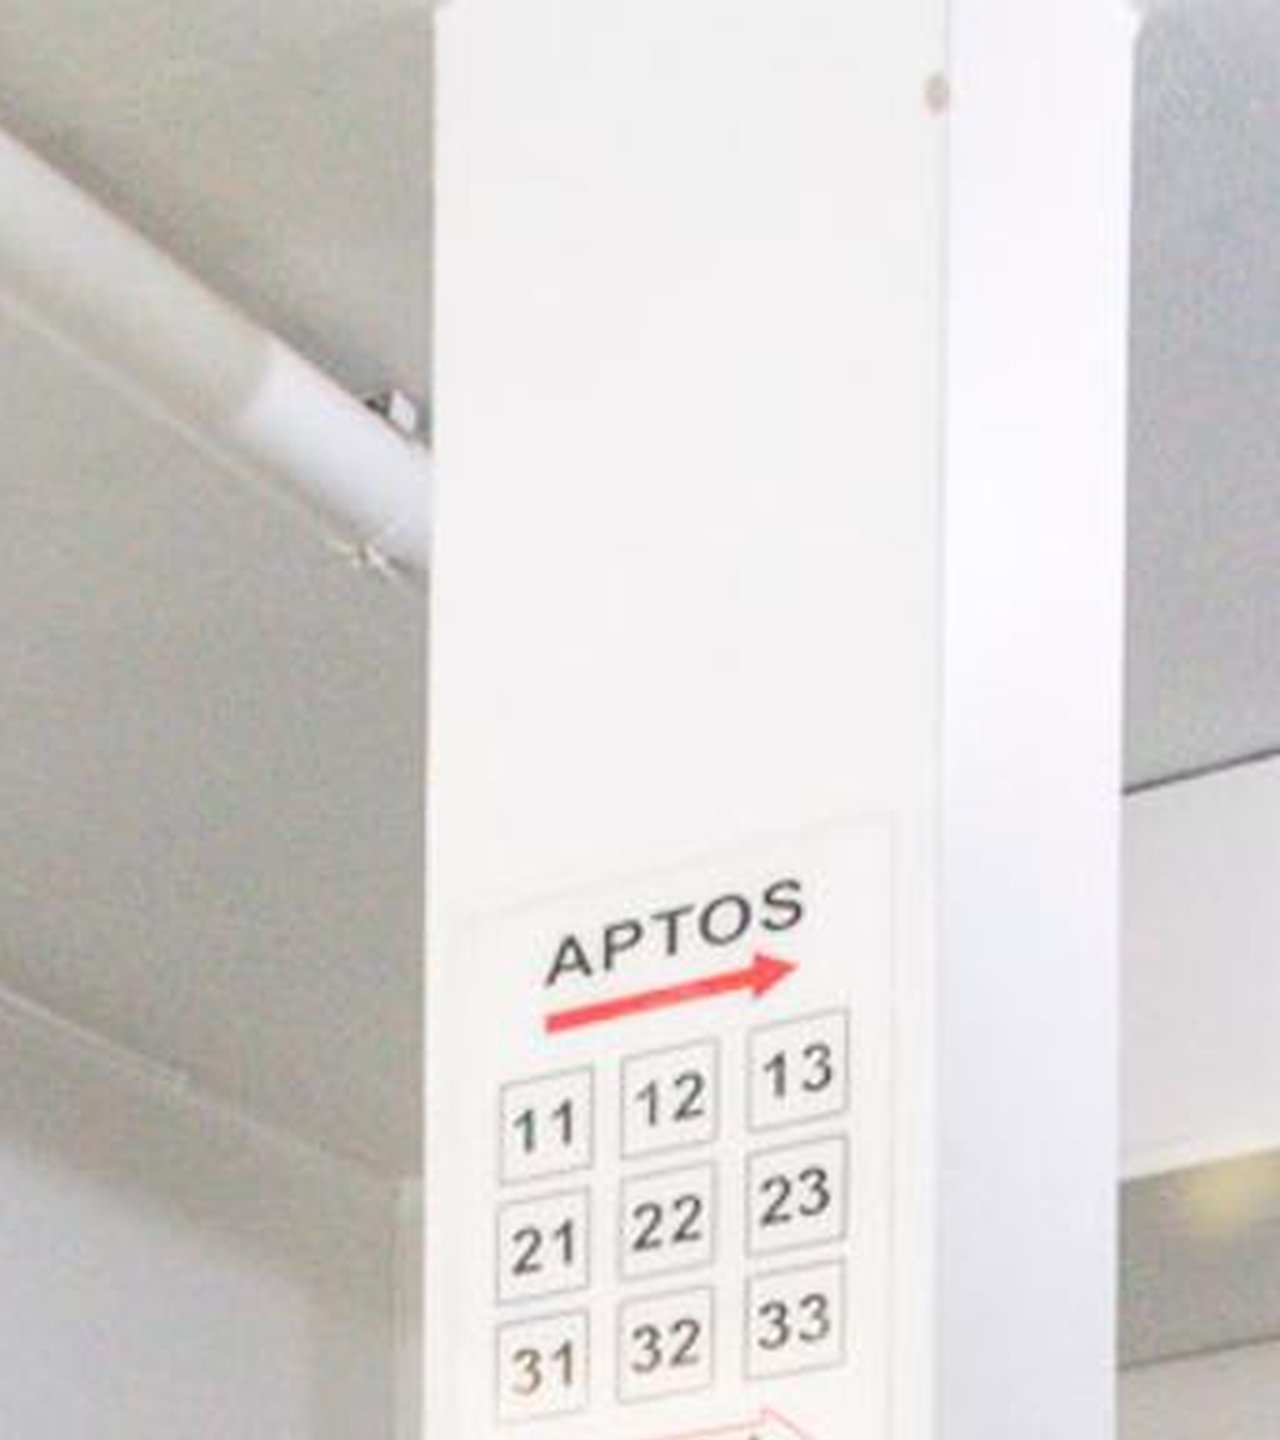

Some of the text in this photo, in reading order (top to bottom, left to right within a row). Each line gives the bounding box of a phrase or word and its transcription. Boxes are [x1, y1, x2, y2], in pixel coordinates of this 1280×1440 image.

[544, 879, 804, 987] APTOS
[636, 1069, 706, 1127] 12
[762, 1043, 833, 1099] 13
[513, 1098, 574, 1154] 11
[631, 1194, 703, 1251] 22
[758, 1167, 831, 1227] 23
[511, 1220, 575, 1276] 21
[631, 1316, 702, 1374] 32
[757, 1292, 831, 1350] 33
[510, 1340, 575, 1397] 31
